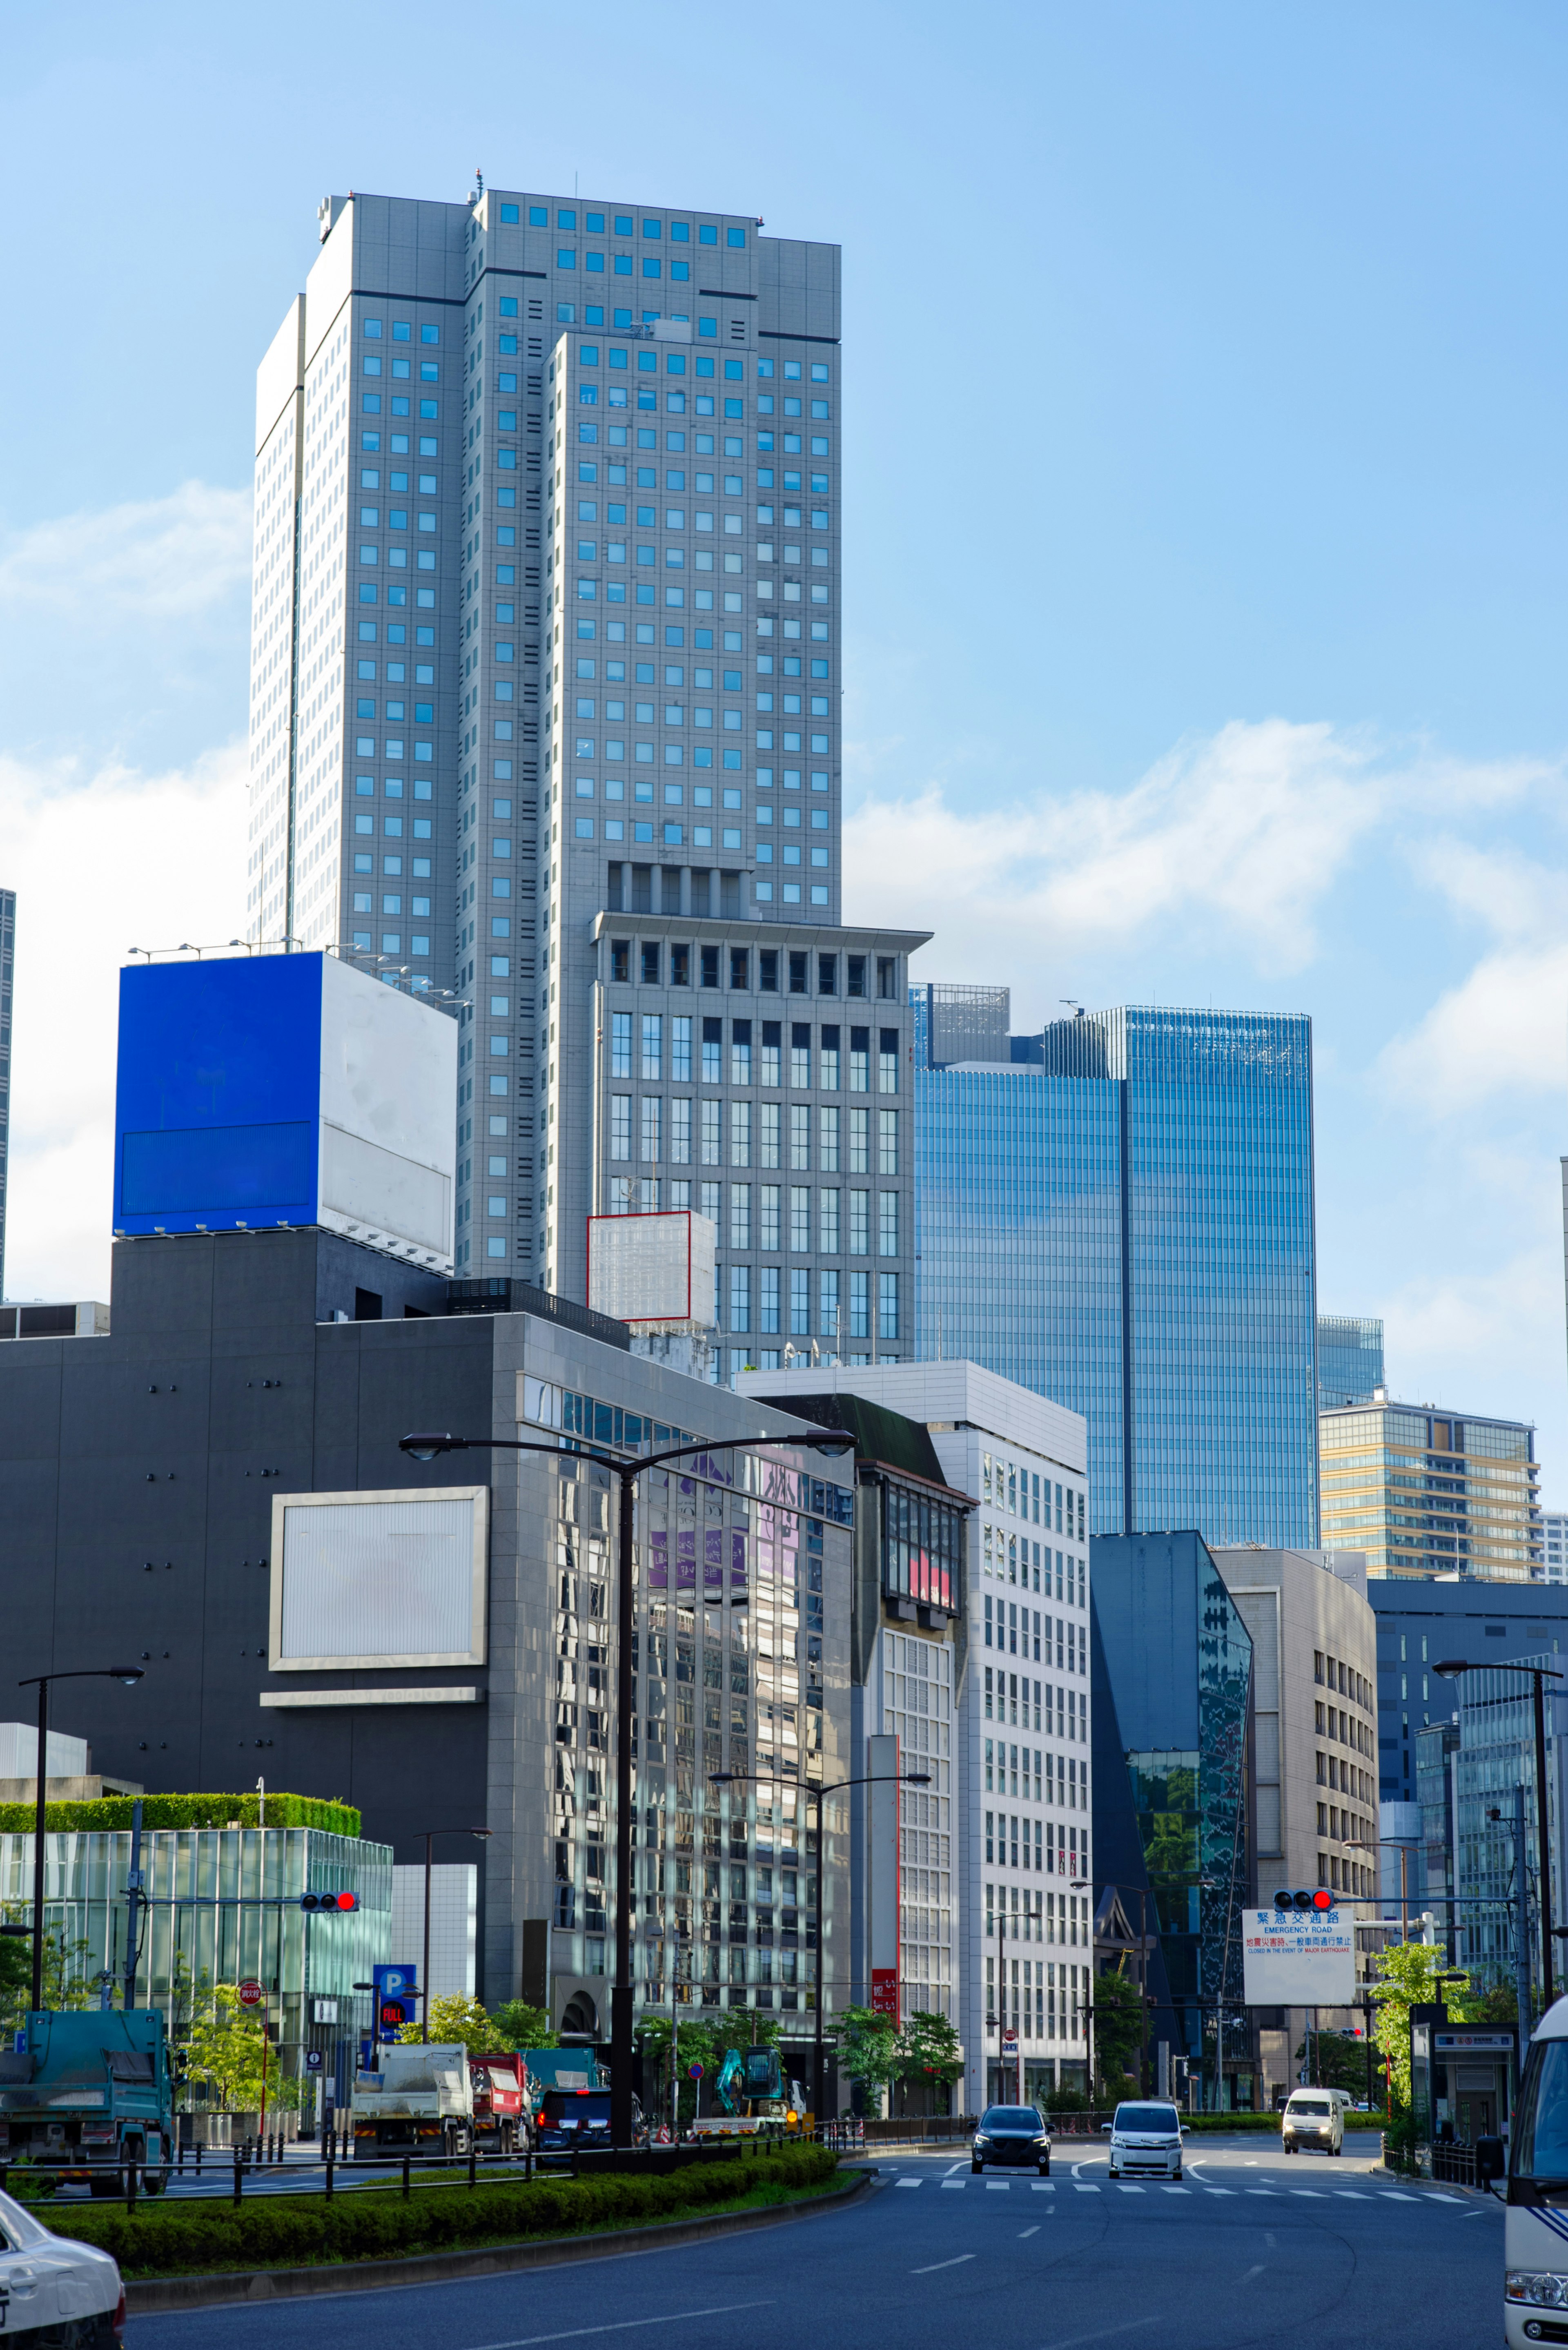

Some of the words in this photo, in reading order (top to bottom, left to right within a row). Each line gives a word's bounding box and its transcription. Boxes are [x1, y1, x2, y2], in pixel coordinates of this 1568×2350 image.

[1257, 1912, 1339, 1924] 緊急交通路
[387, 1973, 402, 1994] P
[241, 1989, 260, 1998] 消火栓
[383, 2008, 402, 2021] FULL
